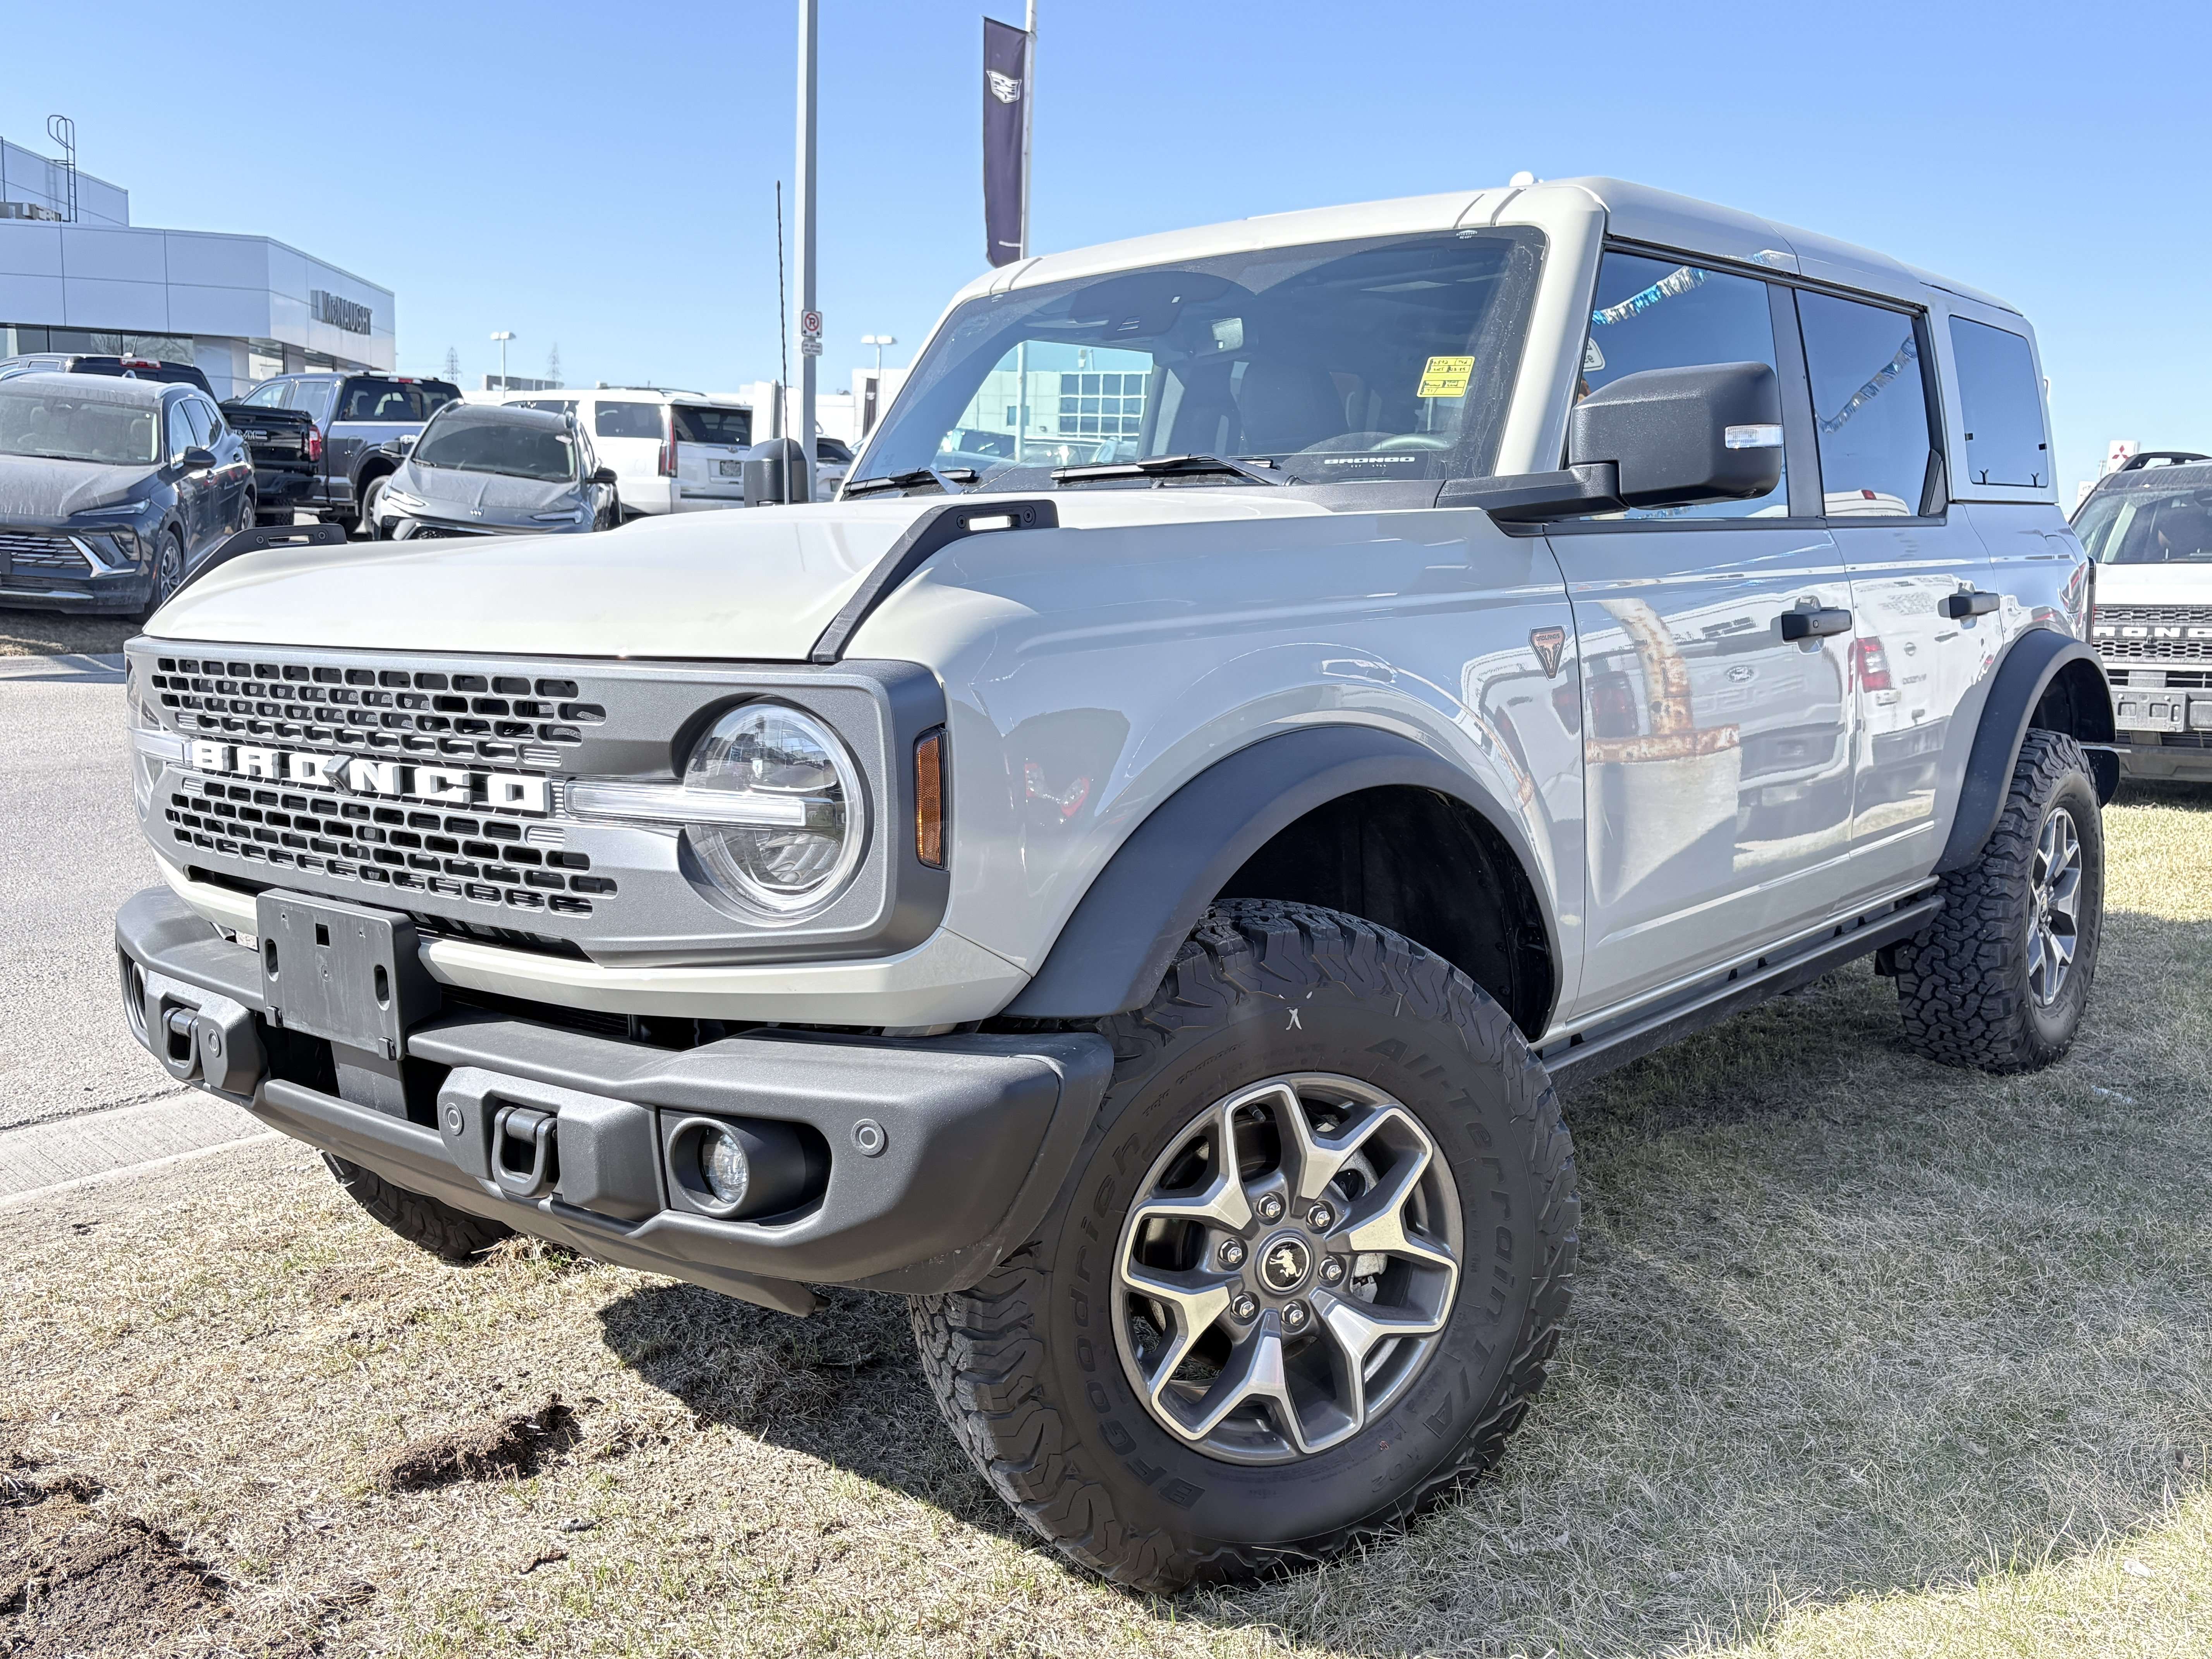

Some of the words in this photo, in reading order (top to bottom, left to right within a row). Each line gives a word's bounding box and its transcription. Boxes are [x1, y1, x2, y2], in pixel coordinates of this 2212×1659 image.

[192, 739, 551, 812] BRONCO
[1364, 1038, 1515, 1326] All-Terrain
[1069, 1132, 1206, 1511] BFGoodrich
[1423, 1339, 1496, 1439] T/A
